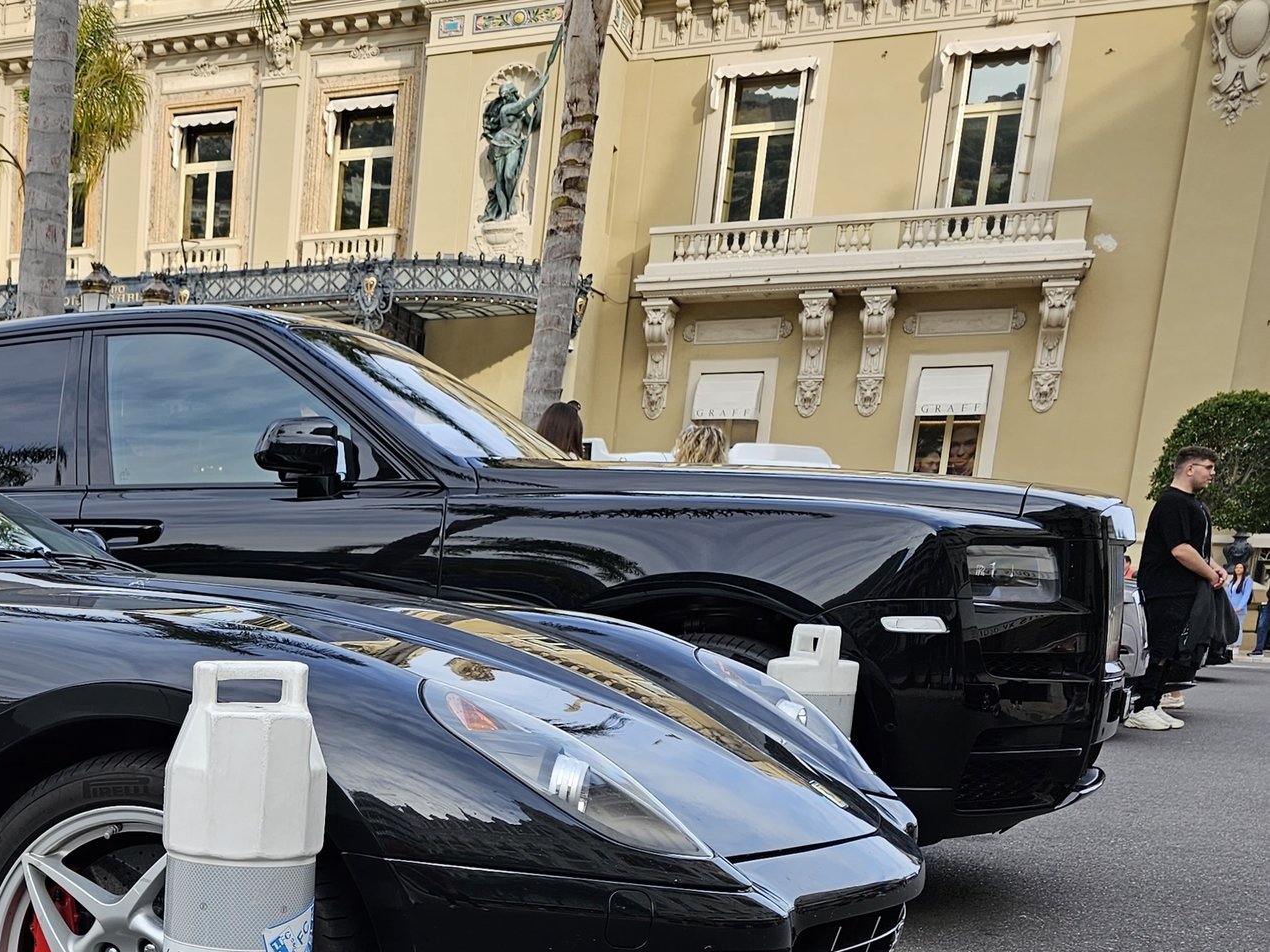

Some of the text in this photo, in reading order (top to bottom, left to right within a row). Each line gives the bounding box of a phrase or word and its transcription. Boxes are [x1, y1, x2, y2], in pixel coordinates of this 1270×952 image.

[696, 408, 750, 417] GRAFF
[920, 403, 981, 413] GRAFF
[83, 777, 151, 799] PIRELLI
